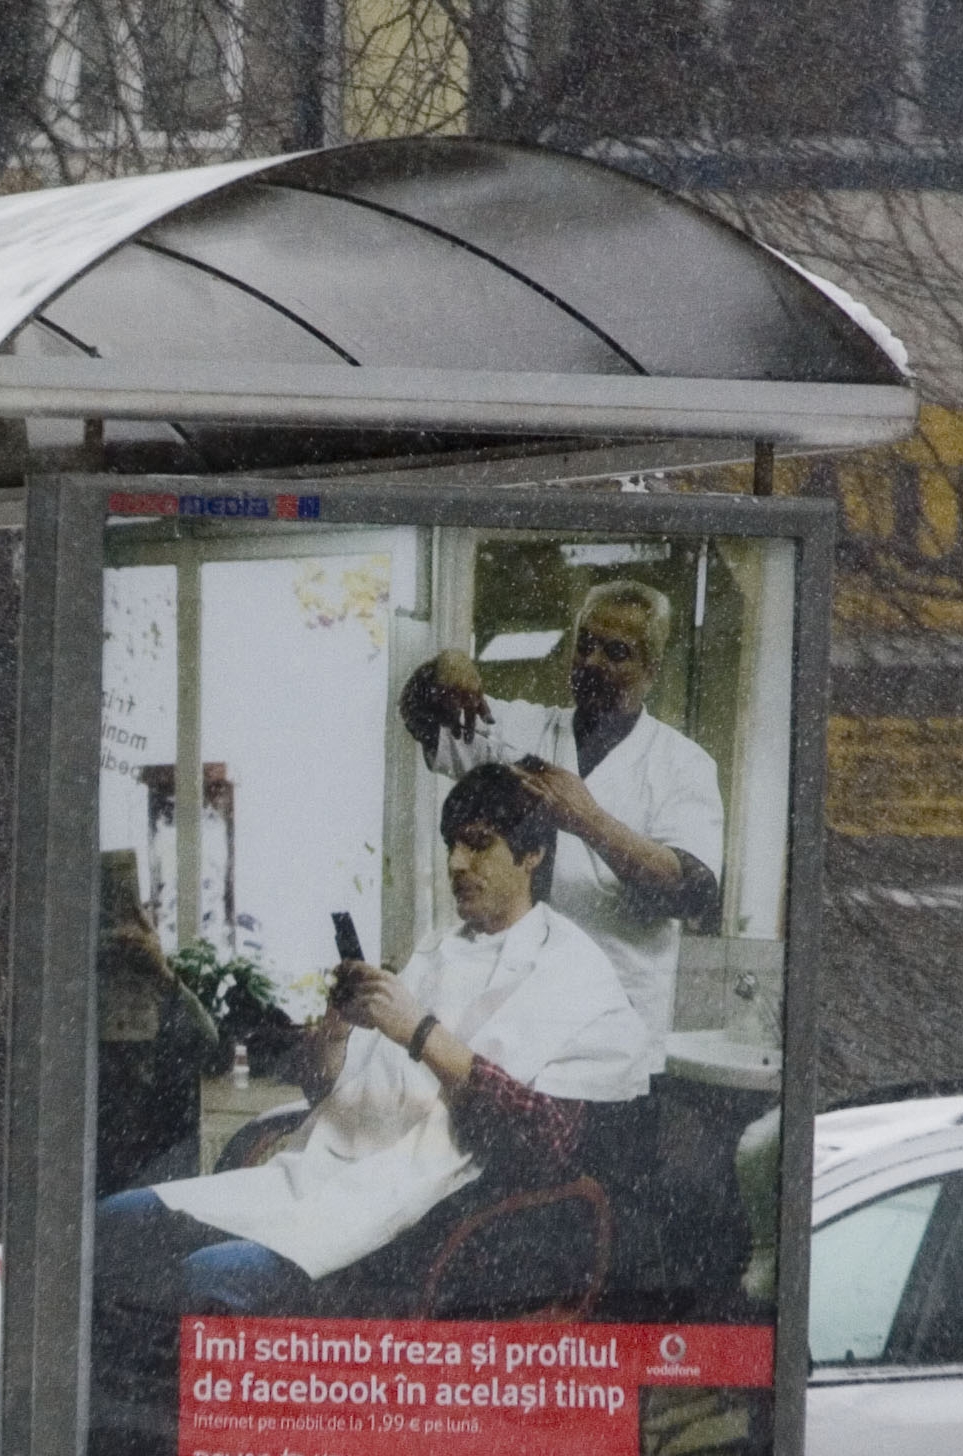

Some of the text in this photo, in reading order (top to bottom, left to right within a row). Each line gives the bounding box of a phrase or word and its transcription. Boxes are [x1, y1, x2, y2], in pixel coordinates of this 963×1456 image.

[193, 1321, 619, 1373] Îmi schimb freza și profilul
[646, 1364, 701, 1377] vodafone
[193, 1372, 625, 1416] de facebook în același timp
[193, 1413, 253, 1430] Internet
[257, 1417, 276, 1434] pe
[280, 1413, 324, 1431] mobil
[327, 1415, 346, 1432] de
[349, 1415, 363, 1432] la
[409, 1416, 421, 1432] €
[424, 1417, 443, 1434] pe
